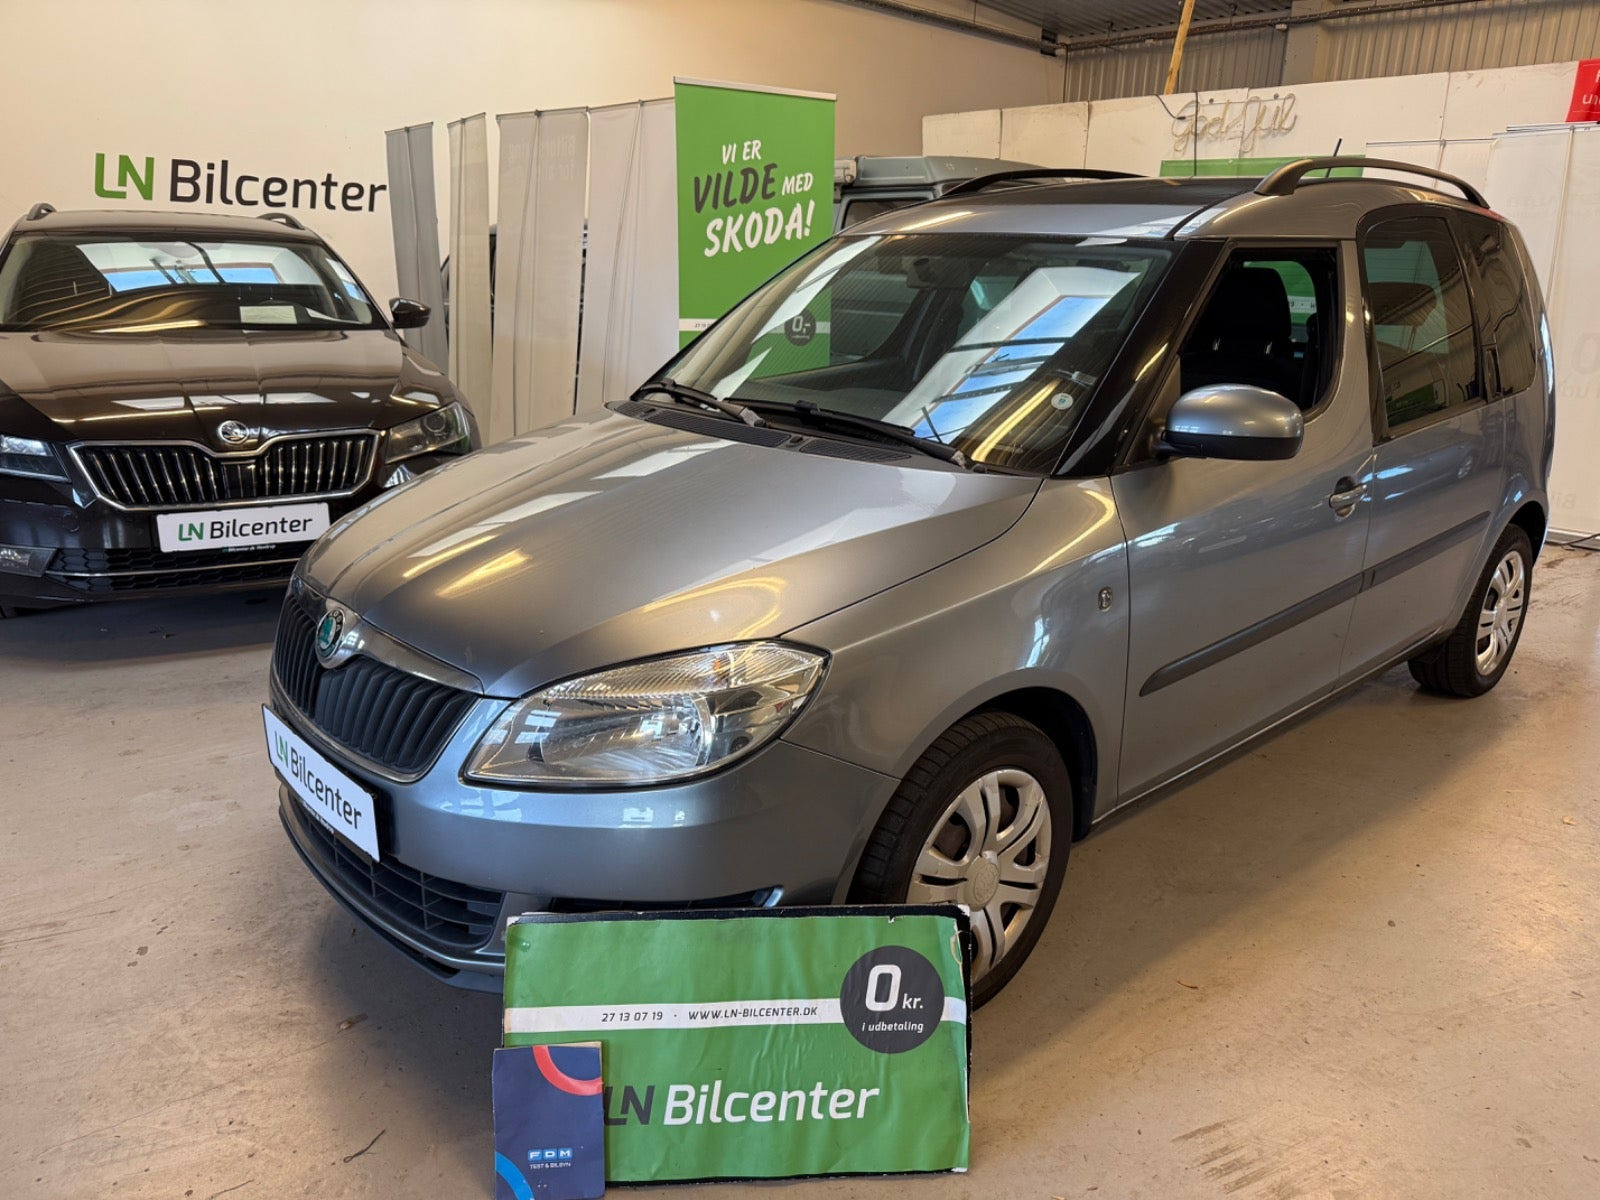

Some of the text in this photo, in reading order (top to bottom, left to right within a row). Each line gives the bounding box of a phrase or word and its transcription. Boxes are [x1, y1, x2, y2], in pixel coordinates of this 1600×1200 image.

[722, 139, 762, 165] VI ER
[94, 152, 387, 212] LN Bilcenter
[694, 162, 814, 213] VILDE MED
[704, 199, 816, 257] SKODA!
[178, 517, 313, 542] LN Bilcenter
[274, 731, 289, 768] LN
[290, 746, 362, 830] Bilcenter
[865, 964, 924, 1011] 0 kr.
[602, 1006, 818, 1023] 27 13 07 19 WWW.LN-BILCENTER.DK
[861, 1021, 924, 1034] i udbetaling
[604, 1080, 880, 1126] LN Bilcenter
[529, 1150, 571, 1159] FDM
